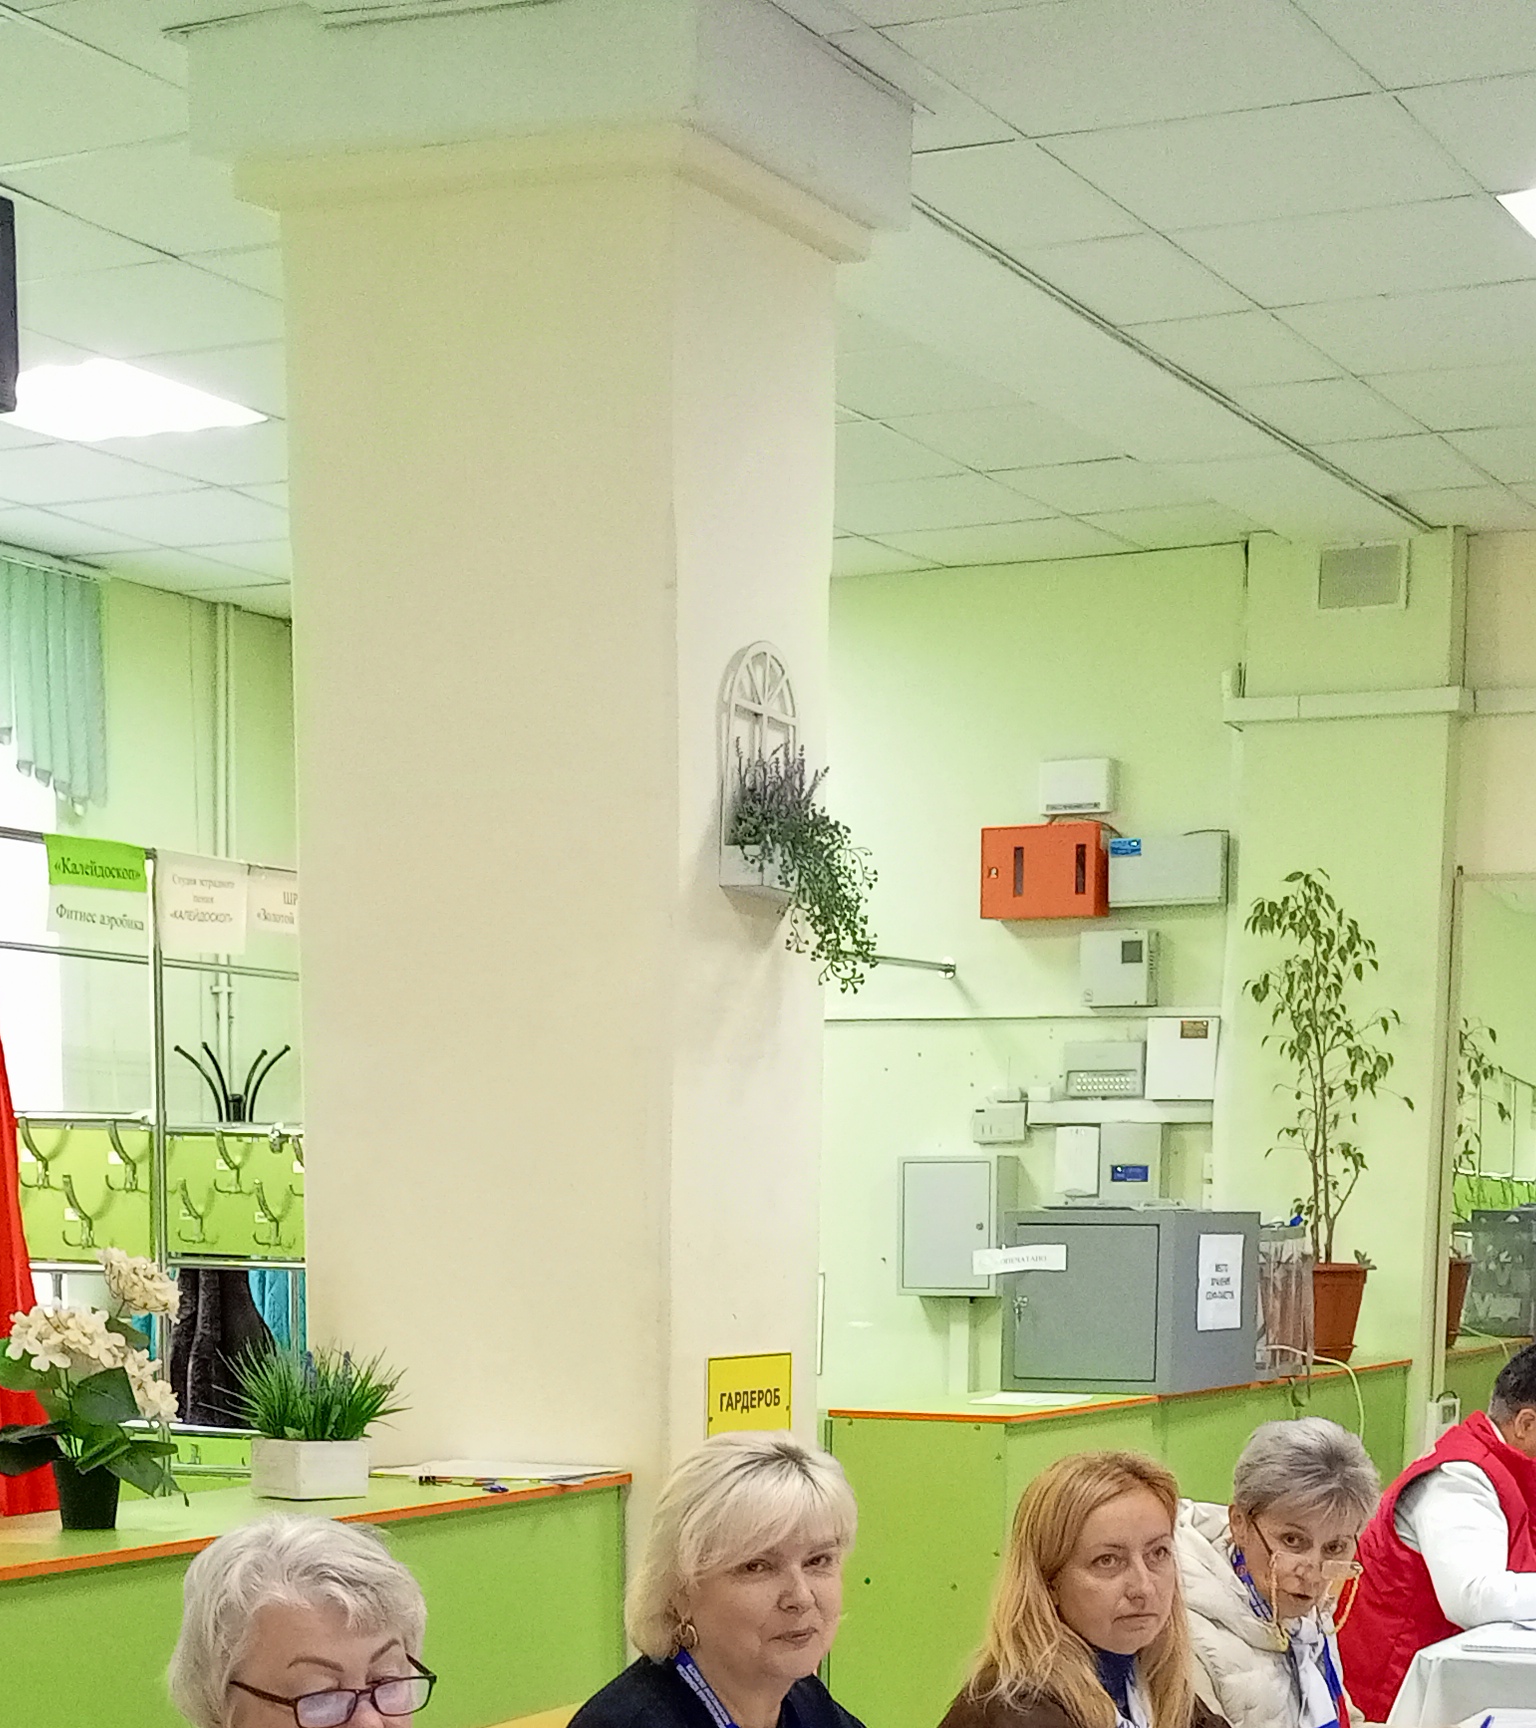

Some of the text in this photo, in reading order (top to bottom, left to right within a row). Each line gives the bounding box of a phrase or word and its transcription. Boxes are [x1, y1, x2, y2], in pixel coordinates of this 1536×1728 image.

[54, 856, 141, 880] «Калейдоскоп»
[56, 903, 144, 931] Фитнес аэробика
[719, 1387, 781, 1414] ГАРДЕРОБ
